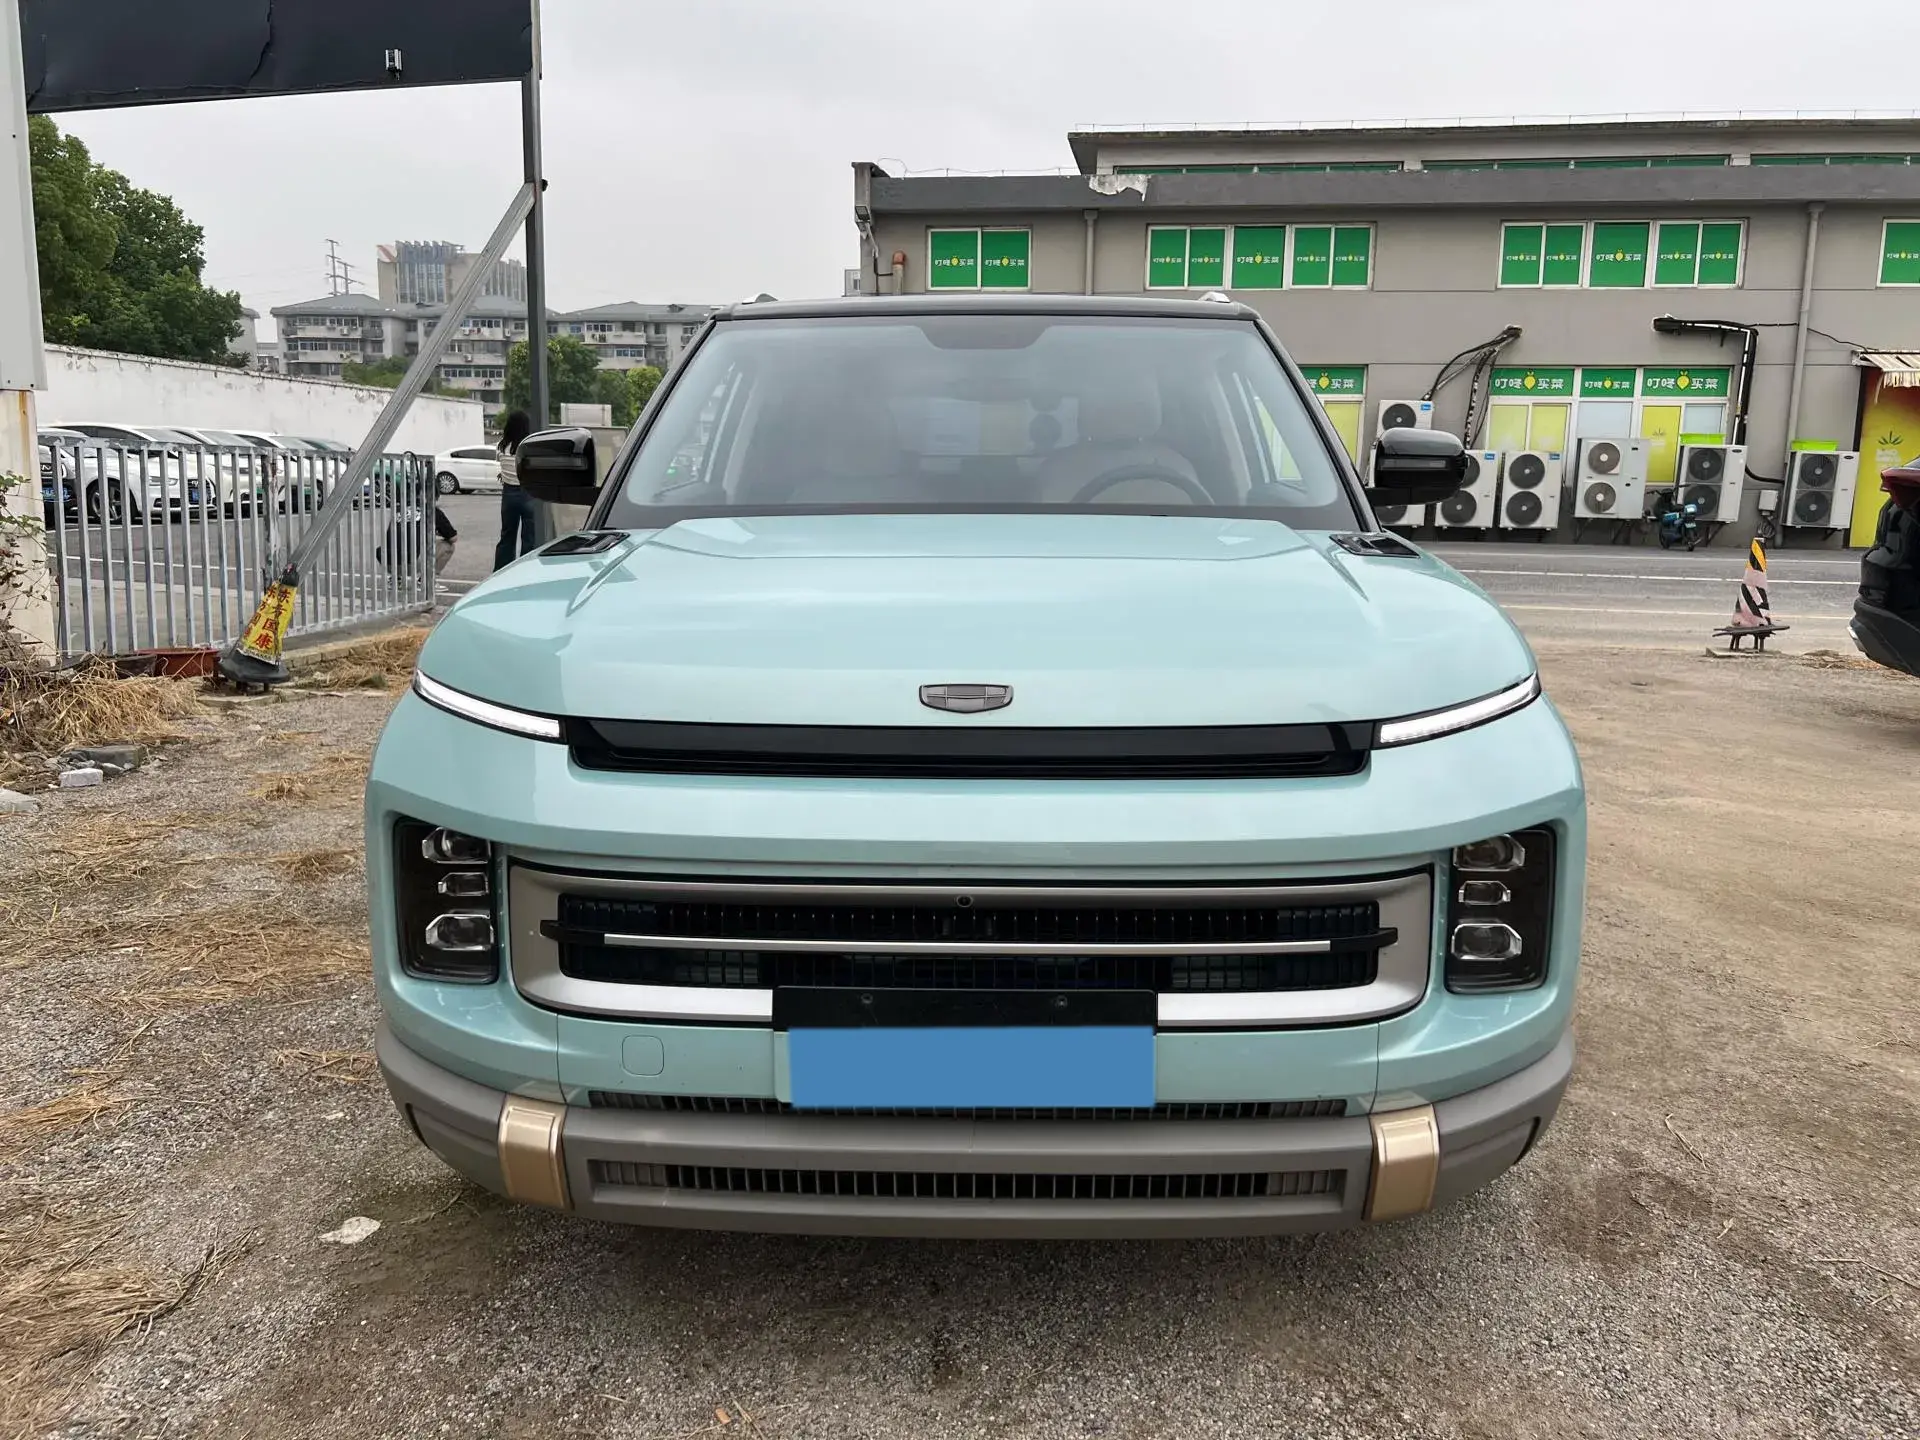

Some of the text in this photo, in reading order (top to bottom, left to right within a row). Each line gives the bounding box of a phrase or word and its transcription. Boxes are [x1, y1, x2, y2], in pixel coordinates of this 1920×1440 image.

[1494, 376, 1565, 390] 叮咚买菜
[1584, 380, 1631, 390] 叮咚买菜
[1646, 376, 1719, 390] 叮咚买菜
